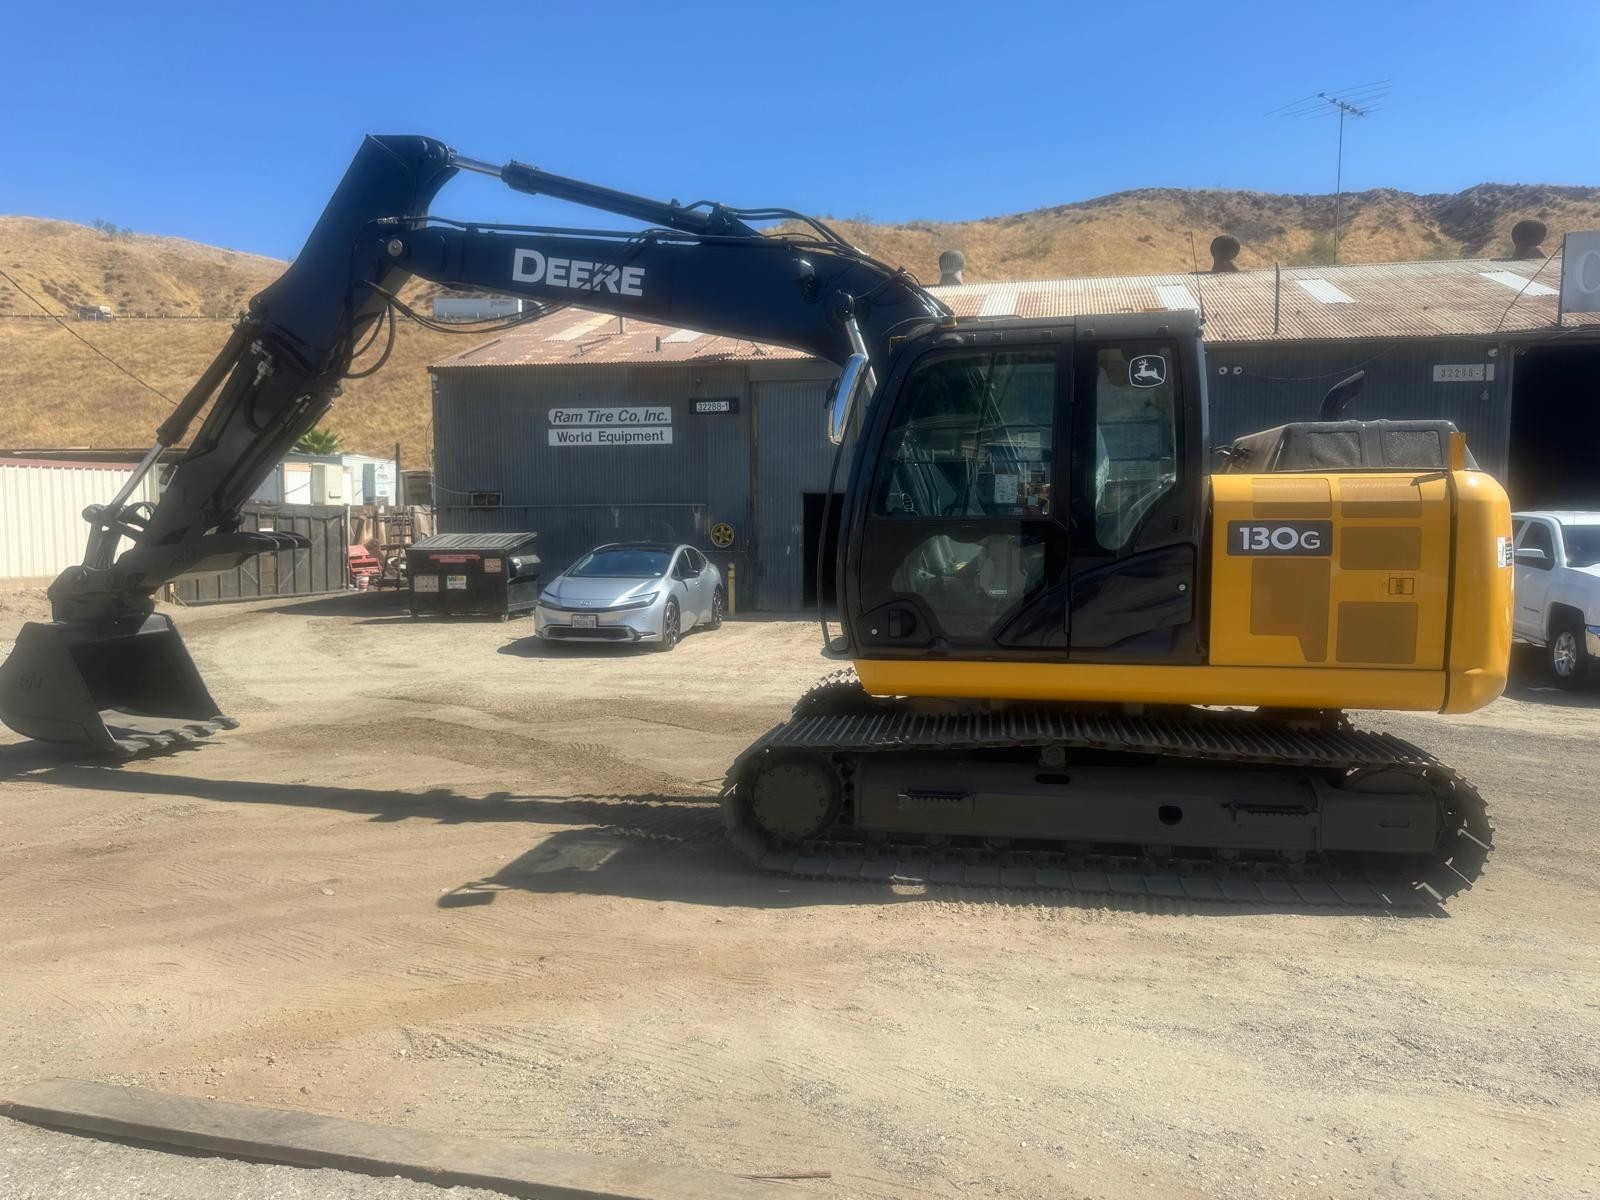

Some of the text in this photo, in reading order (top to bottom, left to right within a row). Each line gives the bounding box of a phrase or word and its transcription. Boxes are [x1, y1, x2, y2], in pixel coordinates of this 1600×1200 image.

[512, 248, 645, 296] DEERE
[697, 402, 729, 411] 32288-1
[553, 410, 583, 423] Ram
[587, 410, 614, 423] Tire
[644, 409, 668, 422] Inc.
[556, 430, 665, 444] World Equipment
[1240, 527, 1320, 550] 130G
